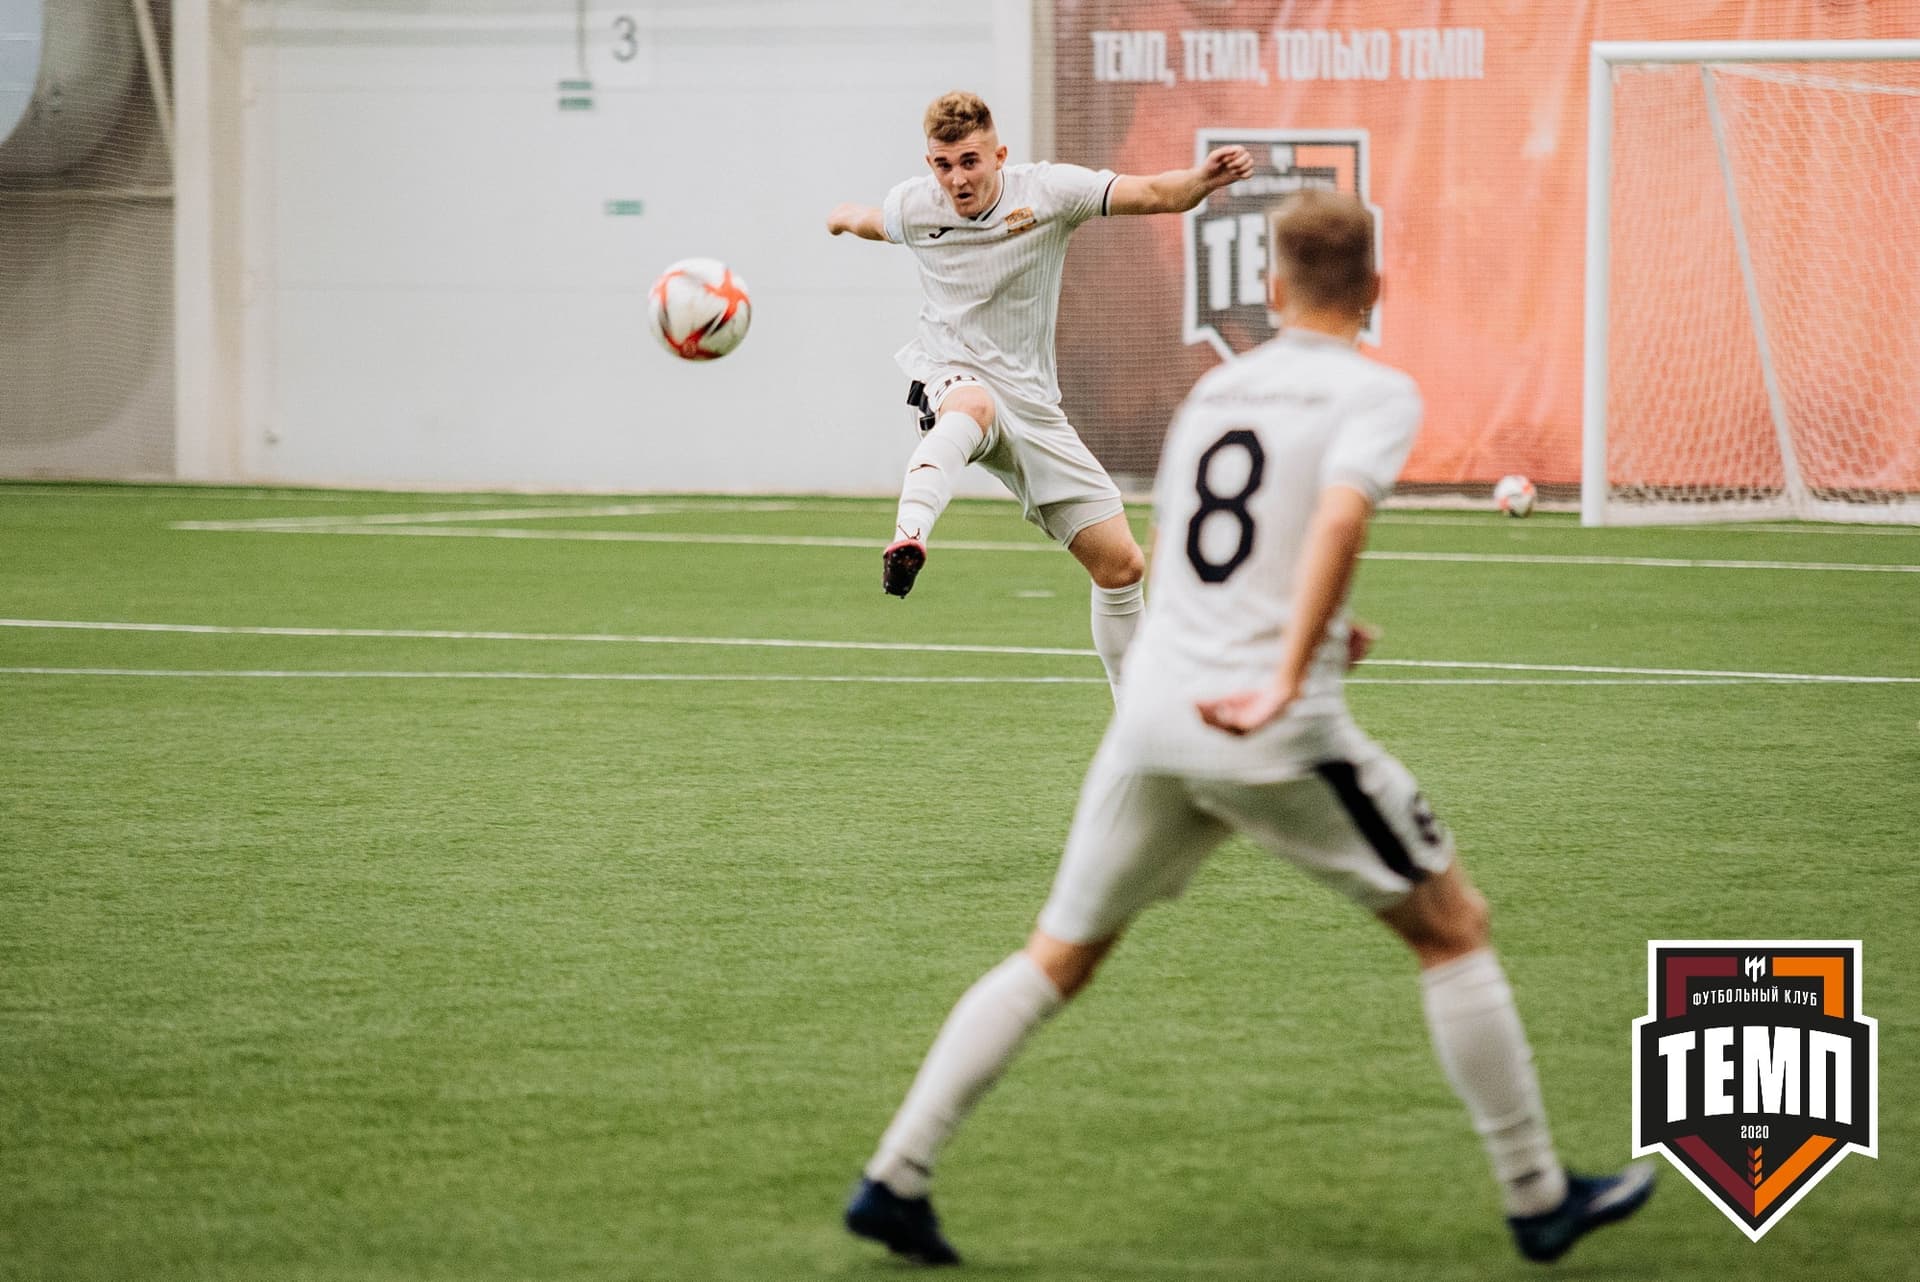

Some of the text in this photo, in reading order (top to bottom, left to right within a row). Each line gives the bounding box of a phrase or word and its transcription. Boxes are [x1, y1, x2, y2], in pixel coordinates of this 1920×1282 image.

[612, 14, 639, 62] 3
[1091, 27, 1484, 87] ТЕМП, ТЕМП, ТОЛЬКО ТЕМП!
[1186, 430, 1265, 583] 8
